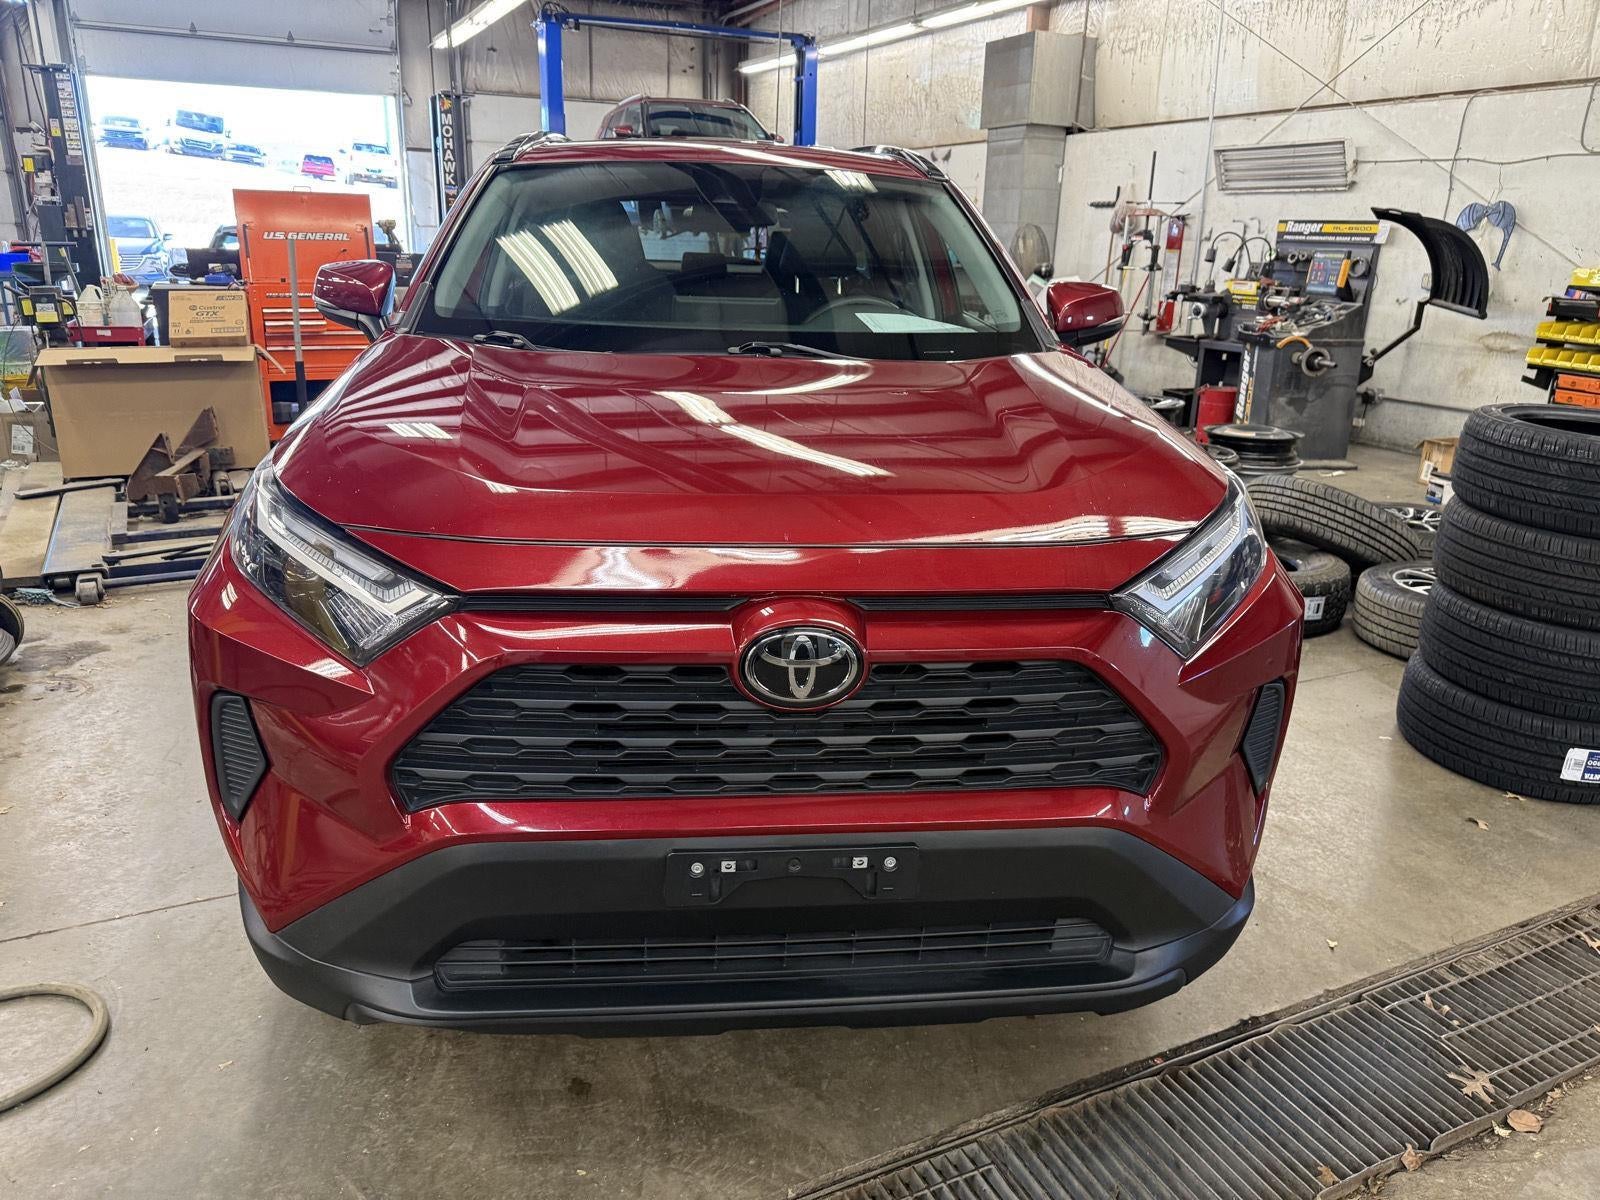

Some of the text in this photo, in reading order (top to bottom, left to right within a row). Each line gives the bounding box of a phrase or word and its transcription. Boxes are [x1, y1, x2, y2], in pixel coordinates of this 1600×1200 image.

[441, 113, 456, 185] MOHAWK
[287, 232, 350, 241] GENERAL
[1286, 221, 1323, 234] Ranger
[1236, 350, 1250, 419] Ranger
